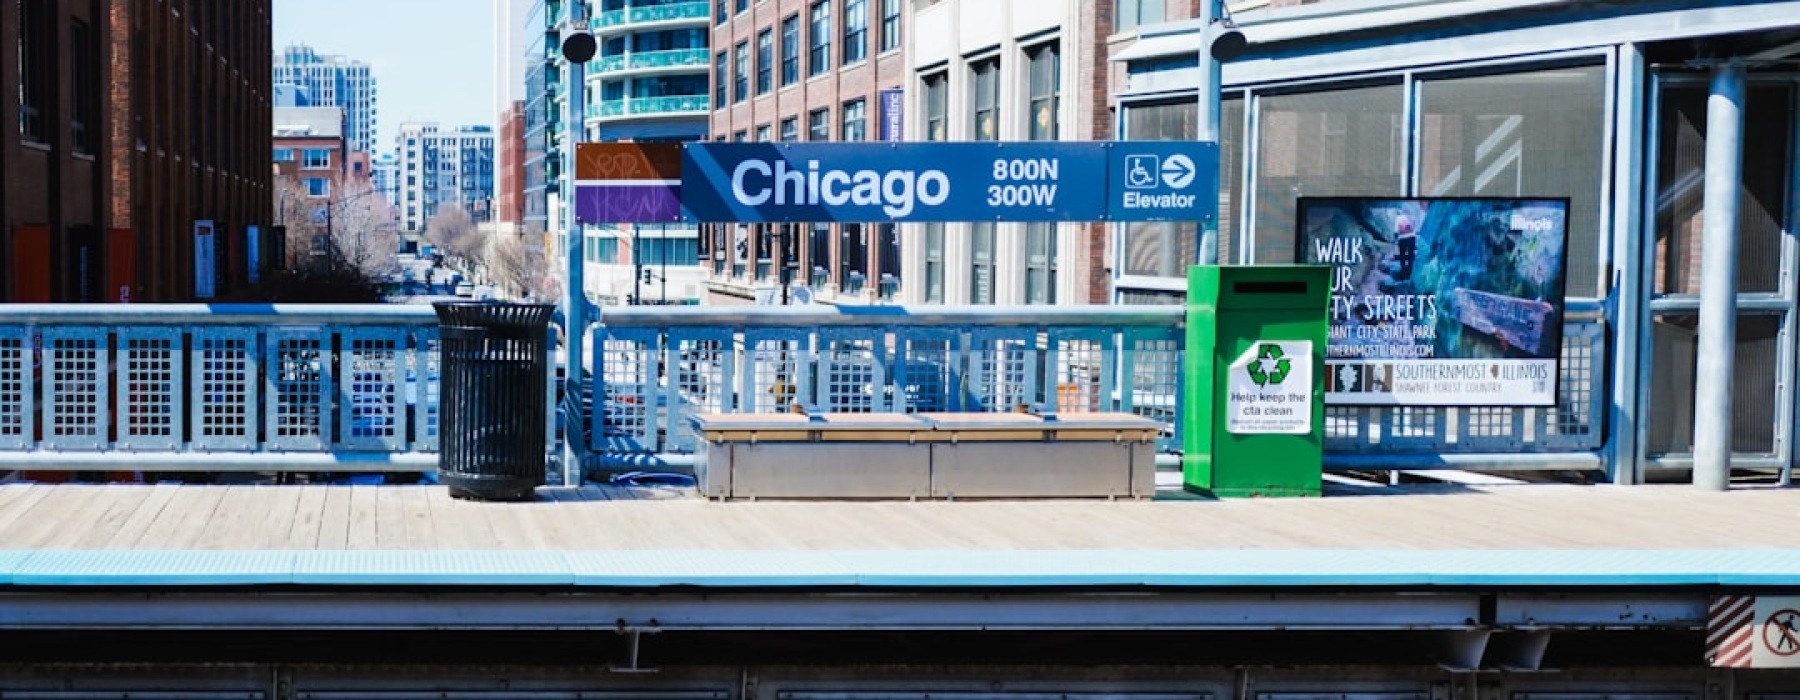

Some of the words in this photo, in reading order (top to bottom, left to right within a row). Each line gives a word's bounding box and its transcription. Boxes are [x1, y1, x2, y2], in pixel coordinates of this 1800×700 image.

[993, 159, 1058, 181] 800N
[732, 159, 949, 217] Chicago
[987, 184, 1057, 206] 300W
[1123, 191, 1195, 209] Elevator
[1315, 237, 1362, 263] WALK
[1330, 294, 1355, 320] TY
[1364, 294, 1437, 321] STREETS
[1357, 324, 1378, 338] CITY
[1413, 324, 1436, 339] PARK
[1395, 362, 1486, 380] SOUTHERNMOST
[1502, 362, 1548, 381] ILLINOIS
[1231, 392, 1256, 404] Help
[1259, 392, 1286, 404] keep
[1289, 392, 1306, 402] the
[1243, 406, 1261, 416] cta
[1264, 406, 1293, 416] clean
